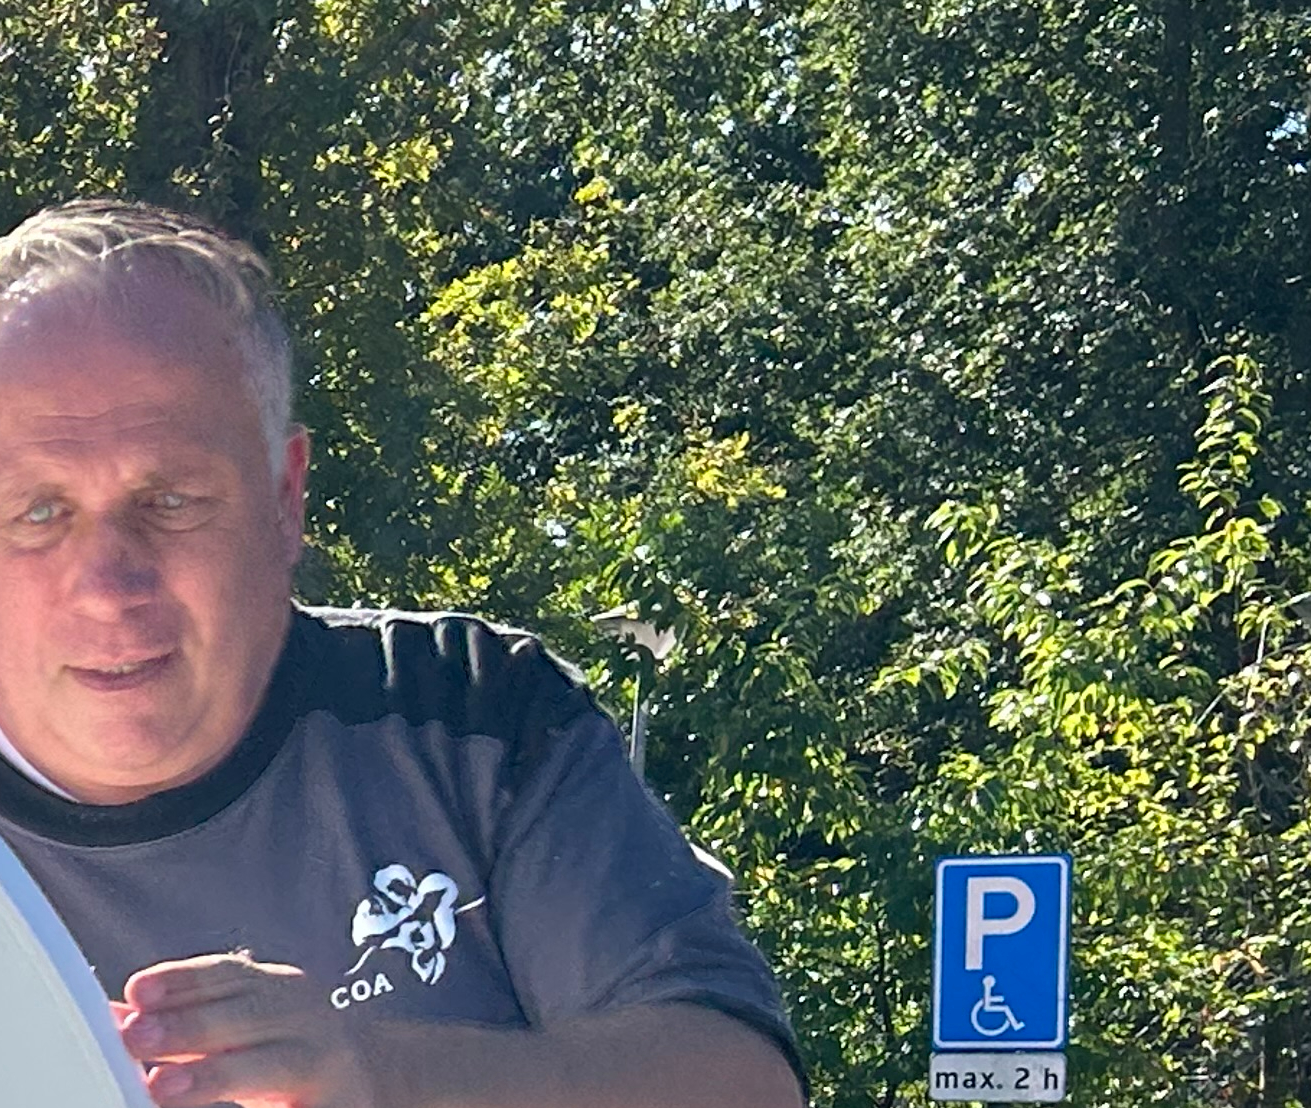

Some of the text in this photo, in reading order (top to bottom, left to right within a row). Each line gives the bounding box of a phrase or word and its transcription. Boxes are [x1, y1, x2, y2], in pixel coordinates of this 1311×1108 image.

[965, 876, 1036, 970] P
[330, 972, 394, 1009] COA
[935, 1067, 1058, 1090] max. 2 h
